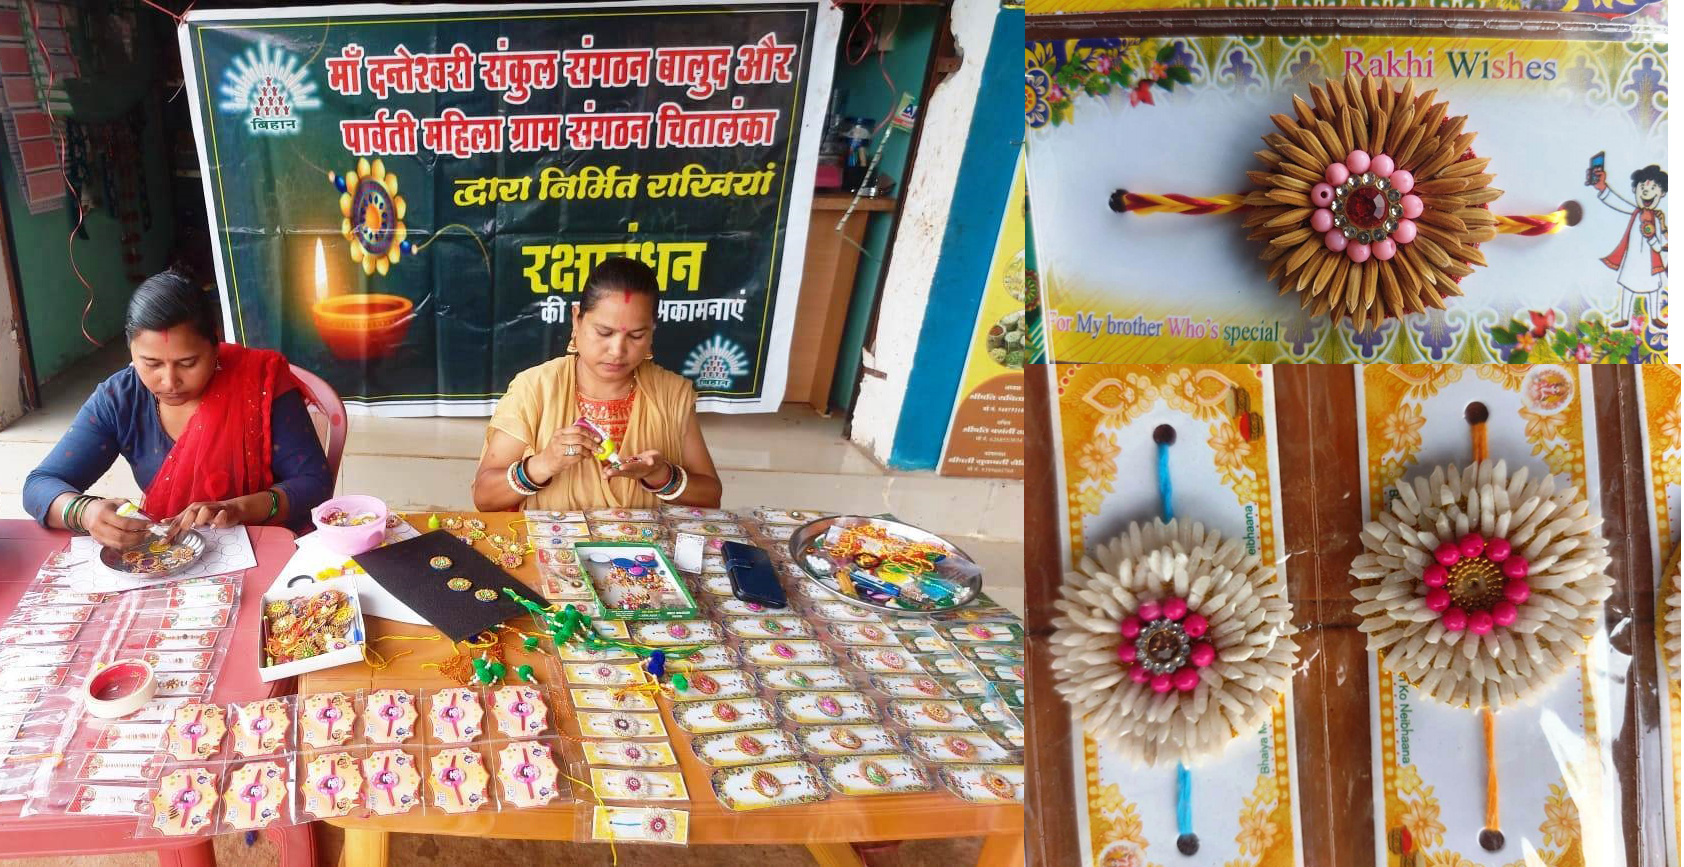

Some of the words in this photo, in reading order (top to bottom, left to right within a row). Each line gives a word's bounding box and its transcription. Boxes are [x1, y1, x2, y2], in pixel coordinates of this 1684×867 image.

[325, 43, 364, 95] माँ
[365, 43, 476, 99] दन्तेश्वरी
[479, 36, 560, 104] संकुल
[563, 34, 653, 88] संगठन
[735, 32, 797, 84] और
[1342, 48, 1434, 78] Rakhi
[1445, 50, 1558, 81] Wishes
[249, 117, 297, 131] बिहान
[340, 108, 419, 156] पार्वती
[421, 107, 505, 159] महिला
[507, 114, 562, 151] ग्राम
[566, 99, 653, 150] संगठन
[656, 96, 780, 149] चितालंका
[453, 175, 532, 207] द्वारा
[538, 166, 640, 201] निर्मित
[647, 162, 776, 198] राखियां
[541, 295, 566, 324] की
[1048, 310, 1072, 332] For
[1076, 312, 1103, 339] My
[1107, 314, 1163, 337] brother
[1167, 316, 1219, 340] Who's
[1223, 320, 1281, 347] special
[1242, 505, 1256, 556] eibhaana
[1399, 684, 1409, 700] Ko
[1400, 704, 1414, 764] Neibhaana
[1257, 737, 1272, 774] Bhaiya
